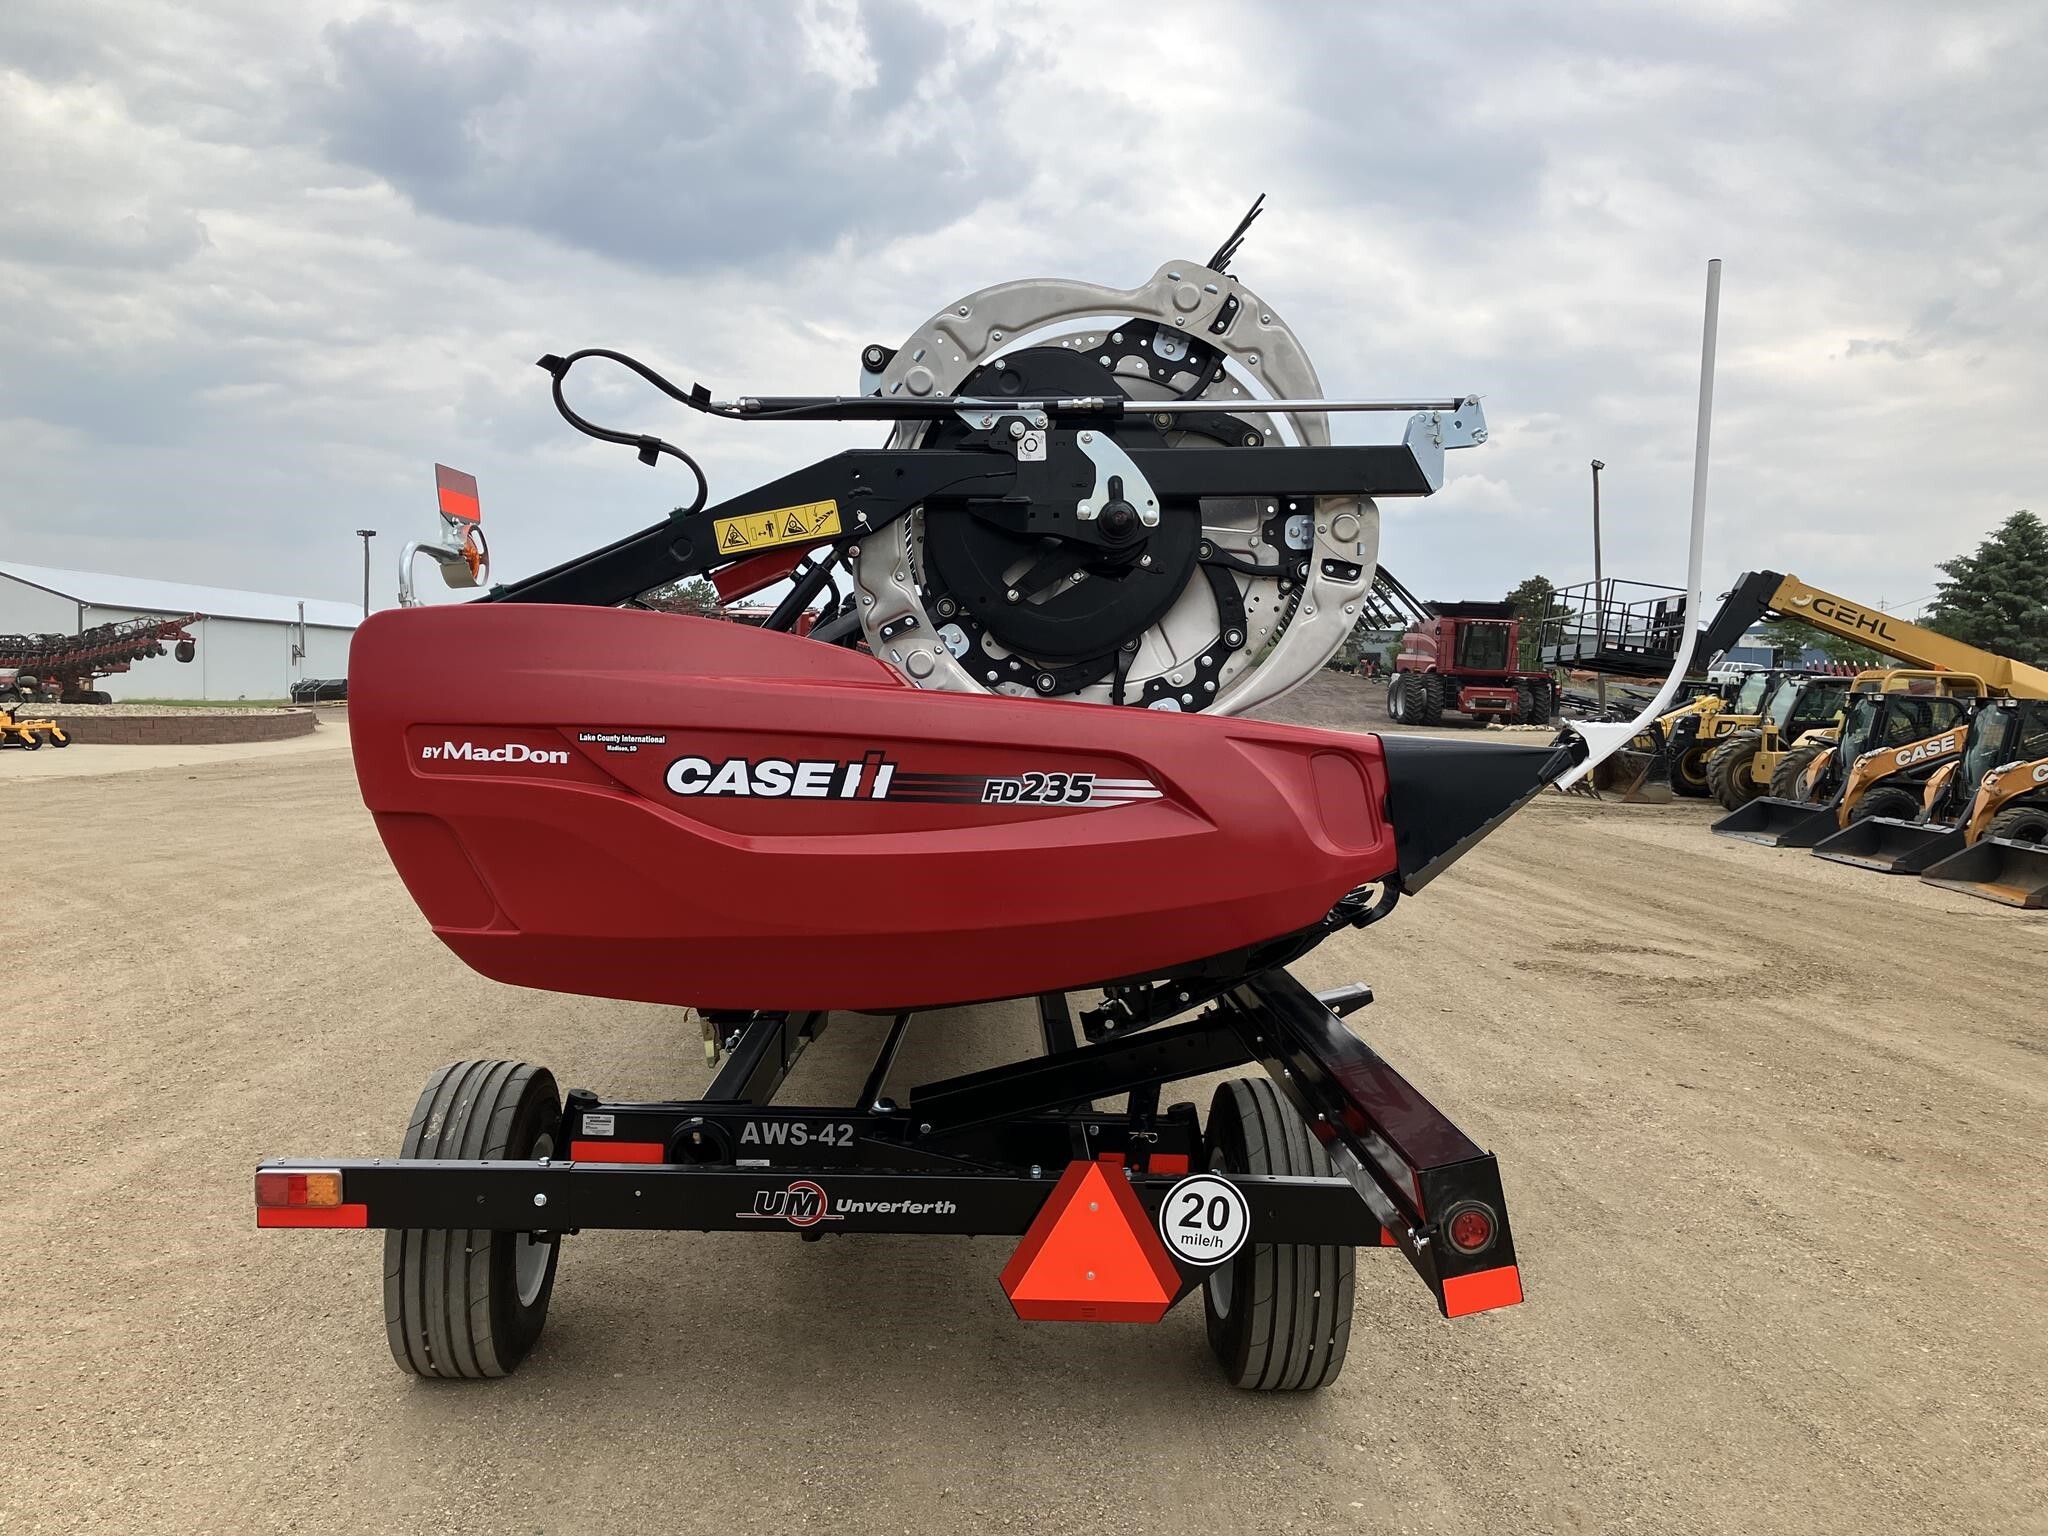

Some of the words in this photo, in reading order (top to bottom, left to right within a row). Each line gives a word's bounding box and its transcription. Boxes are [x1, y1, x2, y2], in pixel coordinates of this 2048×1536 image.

[1812, 598, 1896, 642] GEHL
[422, 746, 443, 759] BY
[443, 741, 569, 764] MacDon
[579, 733, 596, 742] Lake
[597, 734, 621, 744] County
[621, 735, 666, 744] International
[1895, 735, 1955, 766] CASE
[666, 757, 836, 797] CASE
[981, 772, 1096, 805] FD235
[740, 1121, 855, 1147] AWS-42
[836, 1199, 957, 1214] Unverferth
[1178, 1193, 1230, 1231] 20
[1181, 1233, 1223, 1248] mile/h
